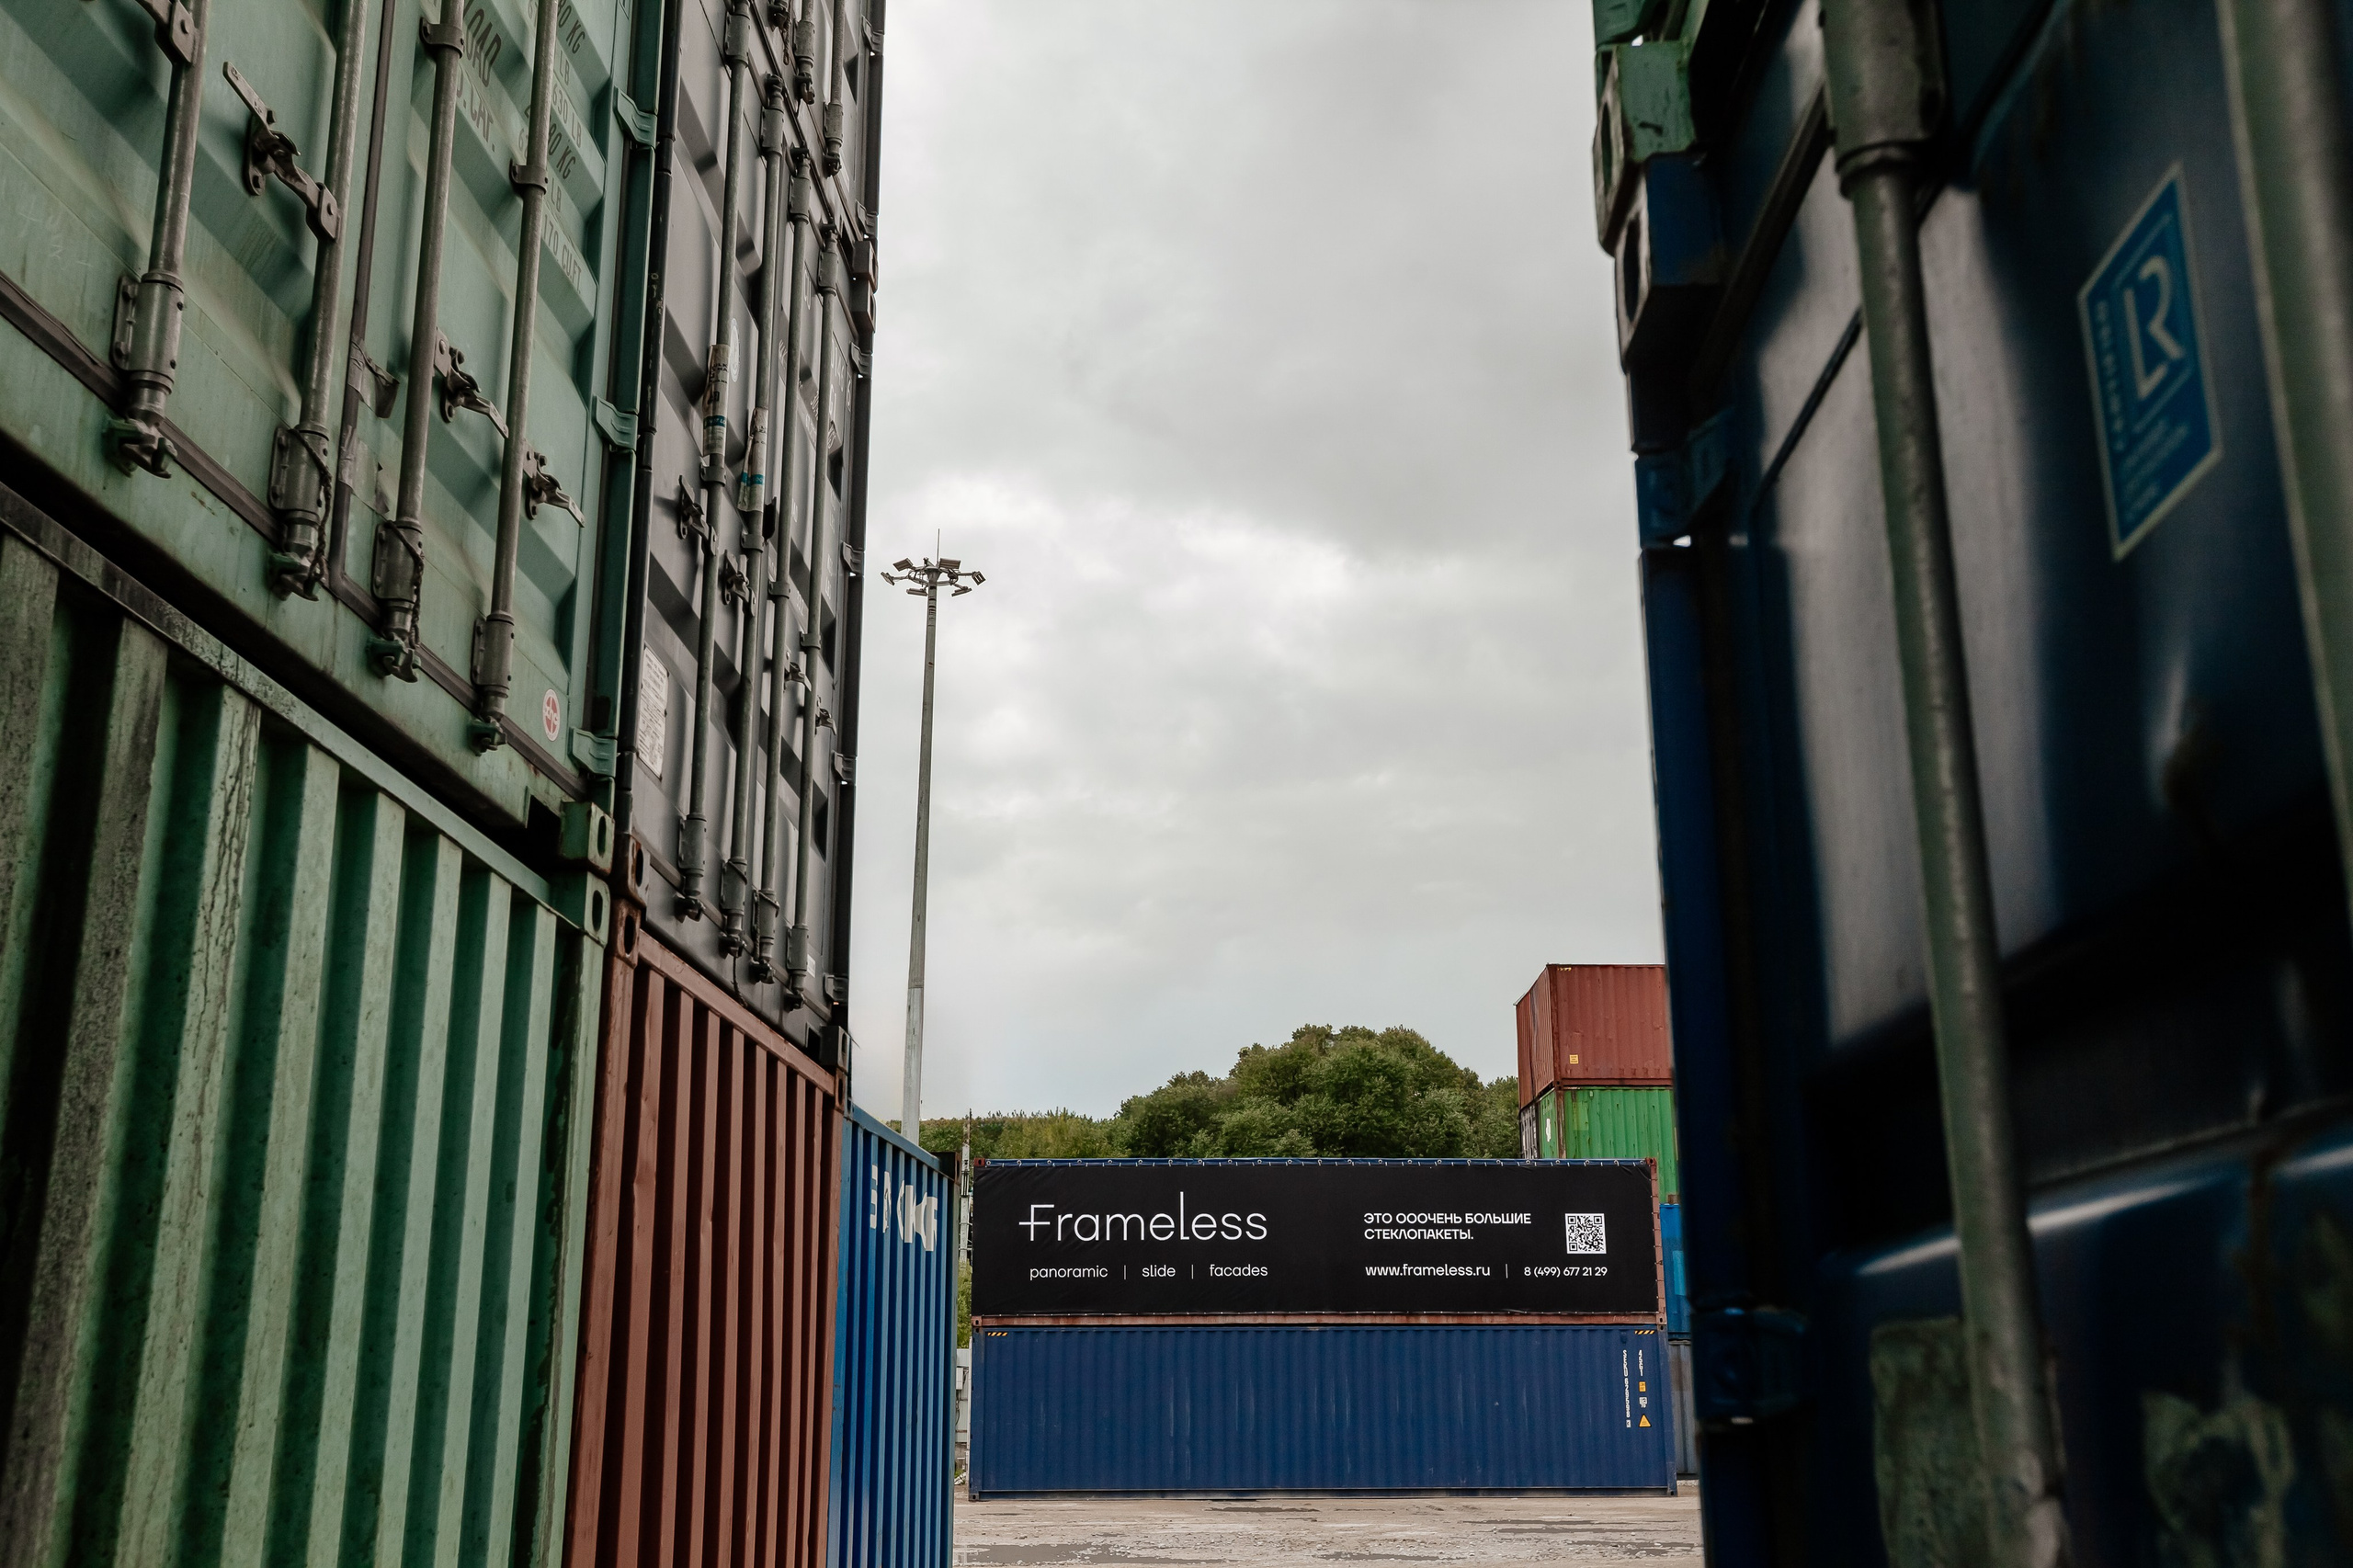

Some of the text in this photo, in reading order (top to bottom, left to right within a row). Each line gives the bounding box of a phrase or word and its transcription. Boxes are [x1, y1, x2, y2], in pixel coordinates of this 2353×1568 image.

[1018, 1190, 1267, 1242] Frameless
[1363, 1212, 1532, 1224] ЭТО ОООЧЕНЬ БОЛЬШИЕ
[1364, 1228, 1474, 1240] СТЕКЛОПАКЕТЫ.
[1029, 1263, 1268, 1281] panoramic slide facades
[1365, 1263, 1608, 1278] www.frameless.ru 8 (499) 677 21 29
